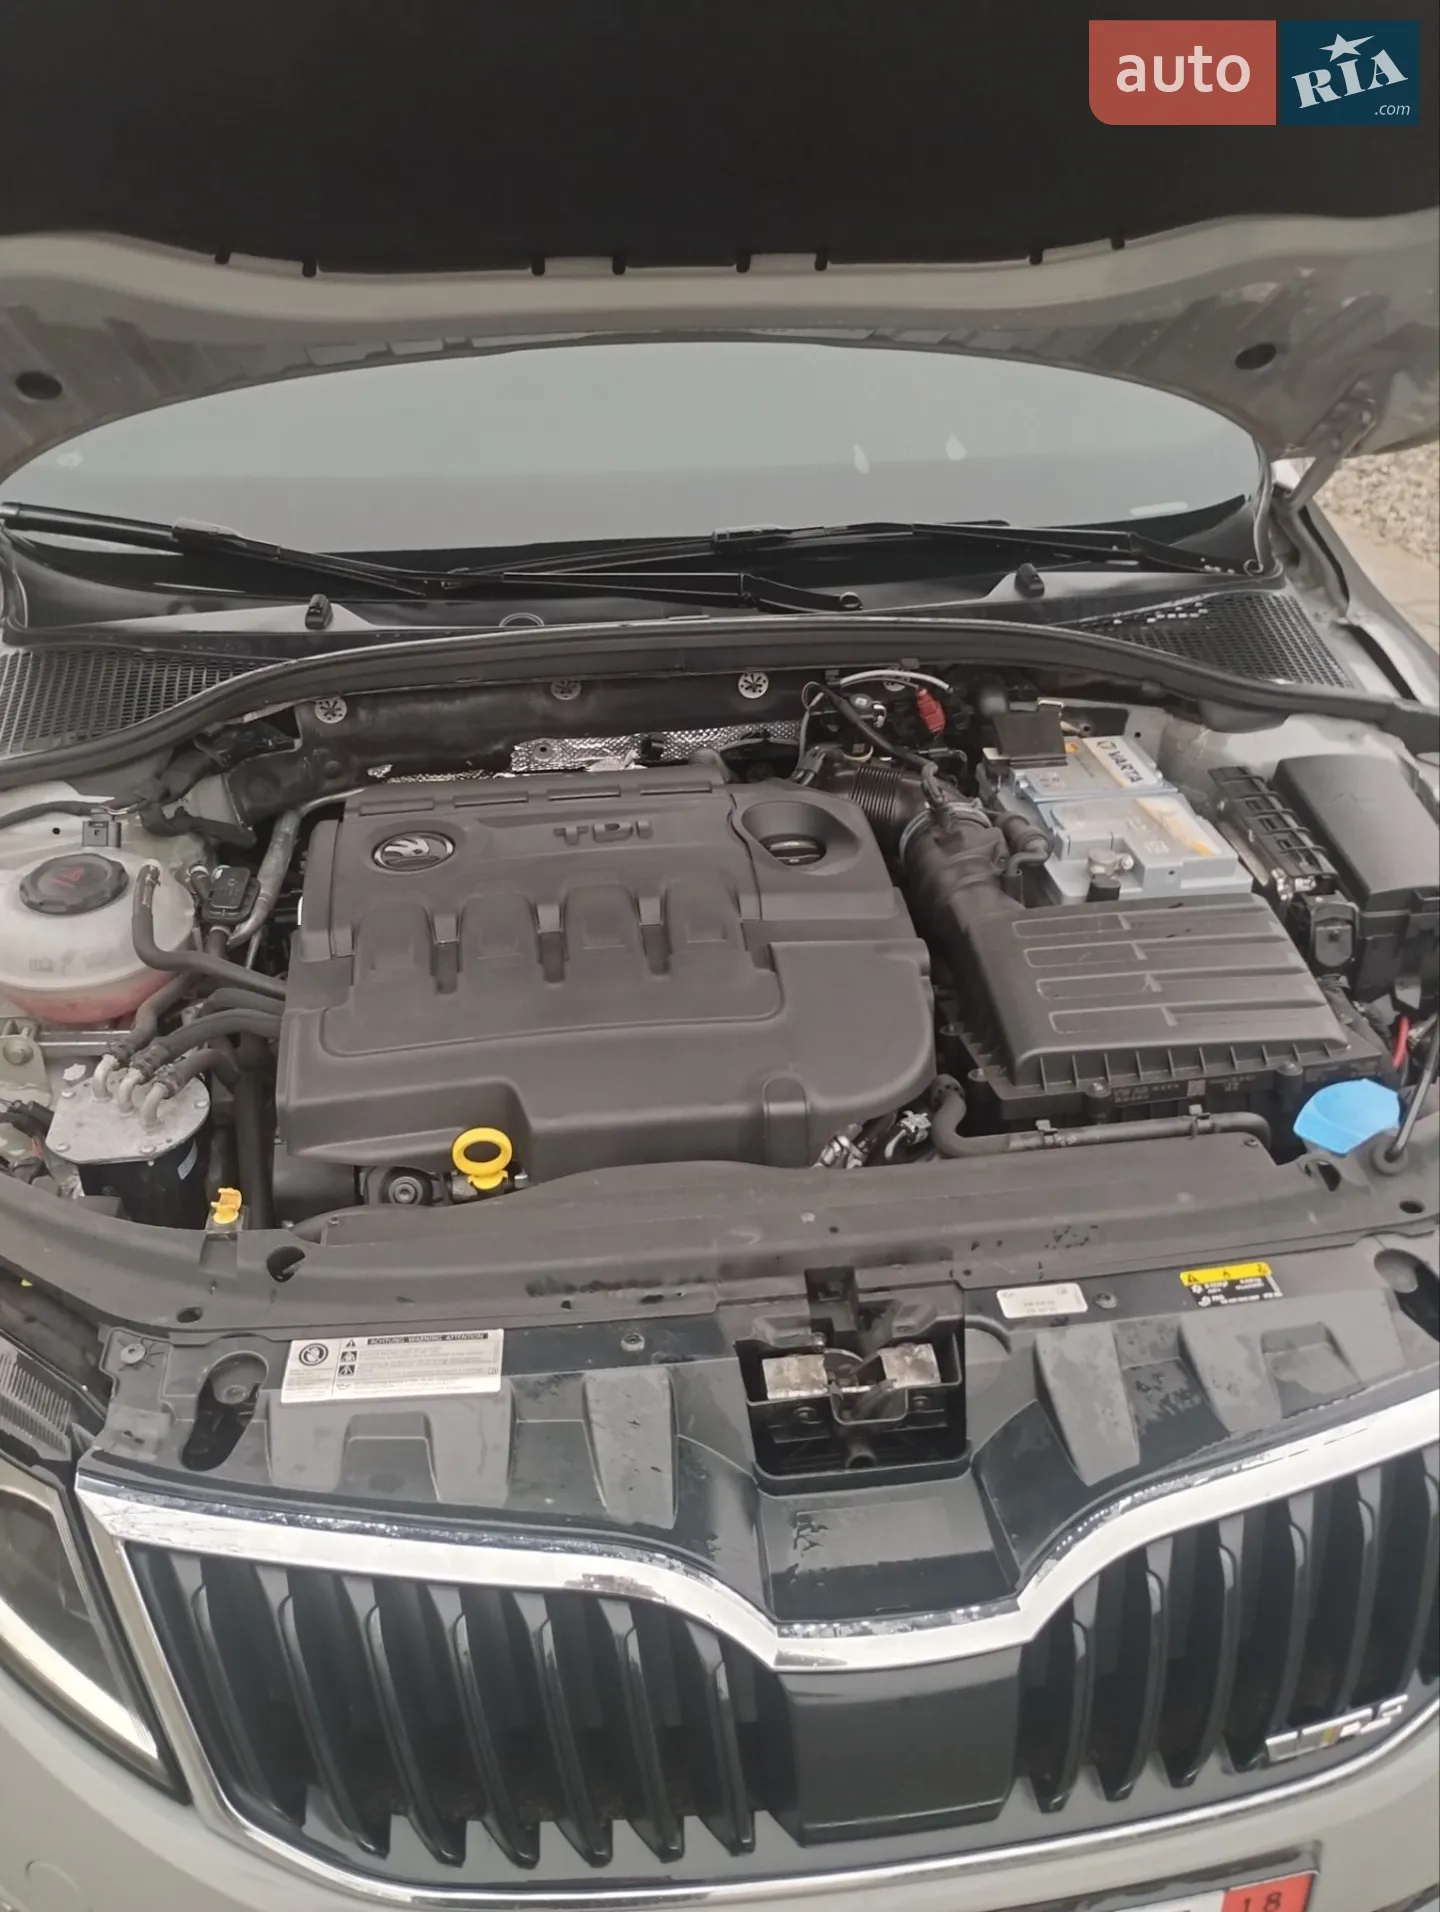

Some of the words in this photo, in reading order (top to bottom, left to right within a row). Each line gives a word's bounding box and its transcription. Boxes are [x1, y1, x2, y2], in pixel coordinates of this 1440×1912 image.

[1108, 750, 1143, 783] VARTA
[553, 819, 653, 846] TDI
[369, 1336, 405, 1345] ACHTUNG
[407, 1334, 442, 1343] WARNING
[444, 1332, 485, 1341] ATTENTION
